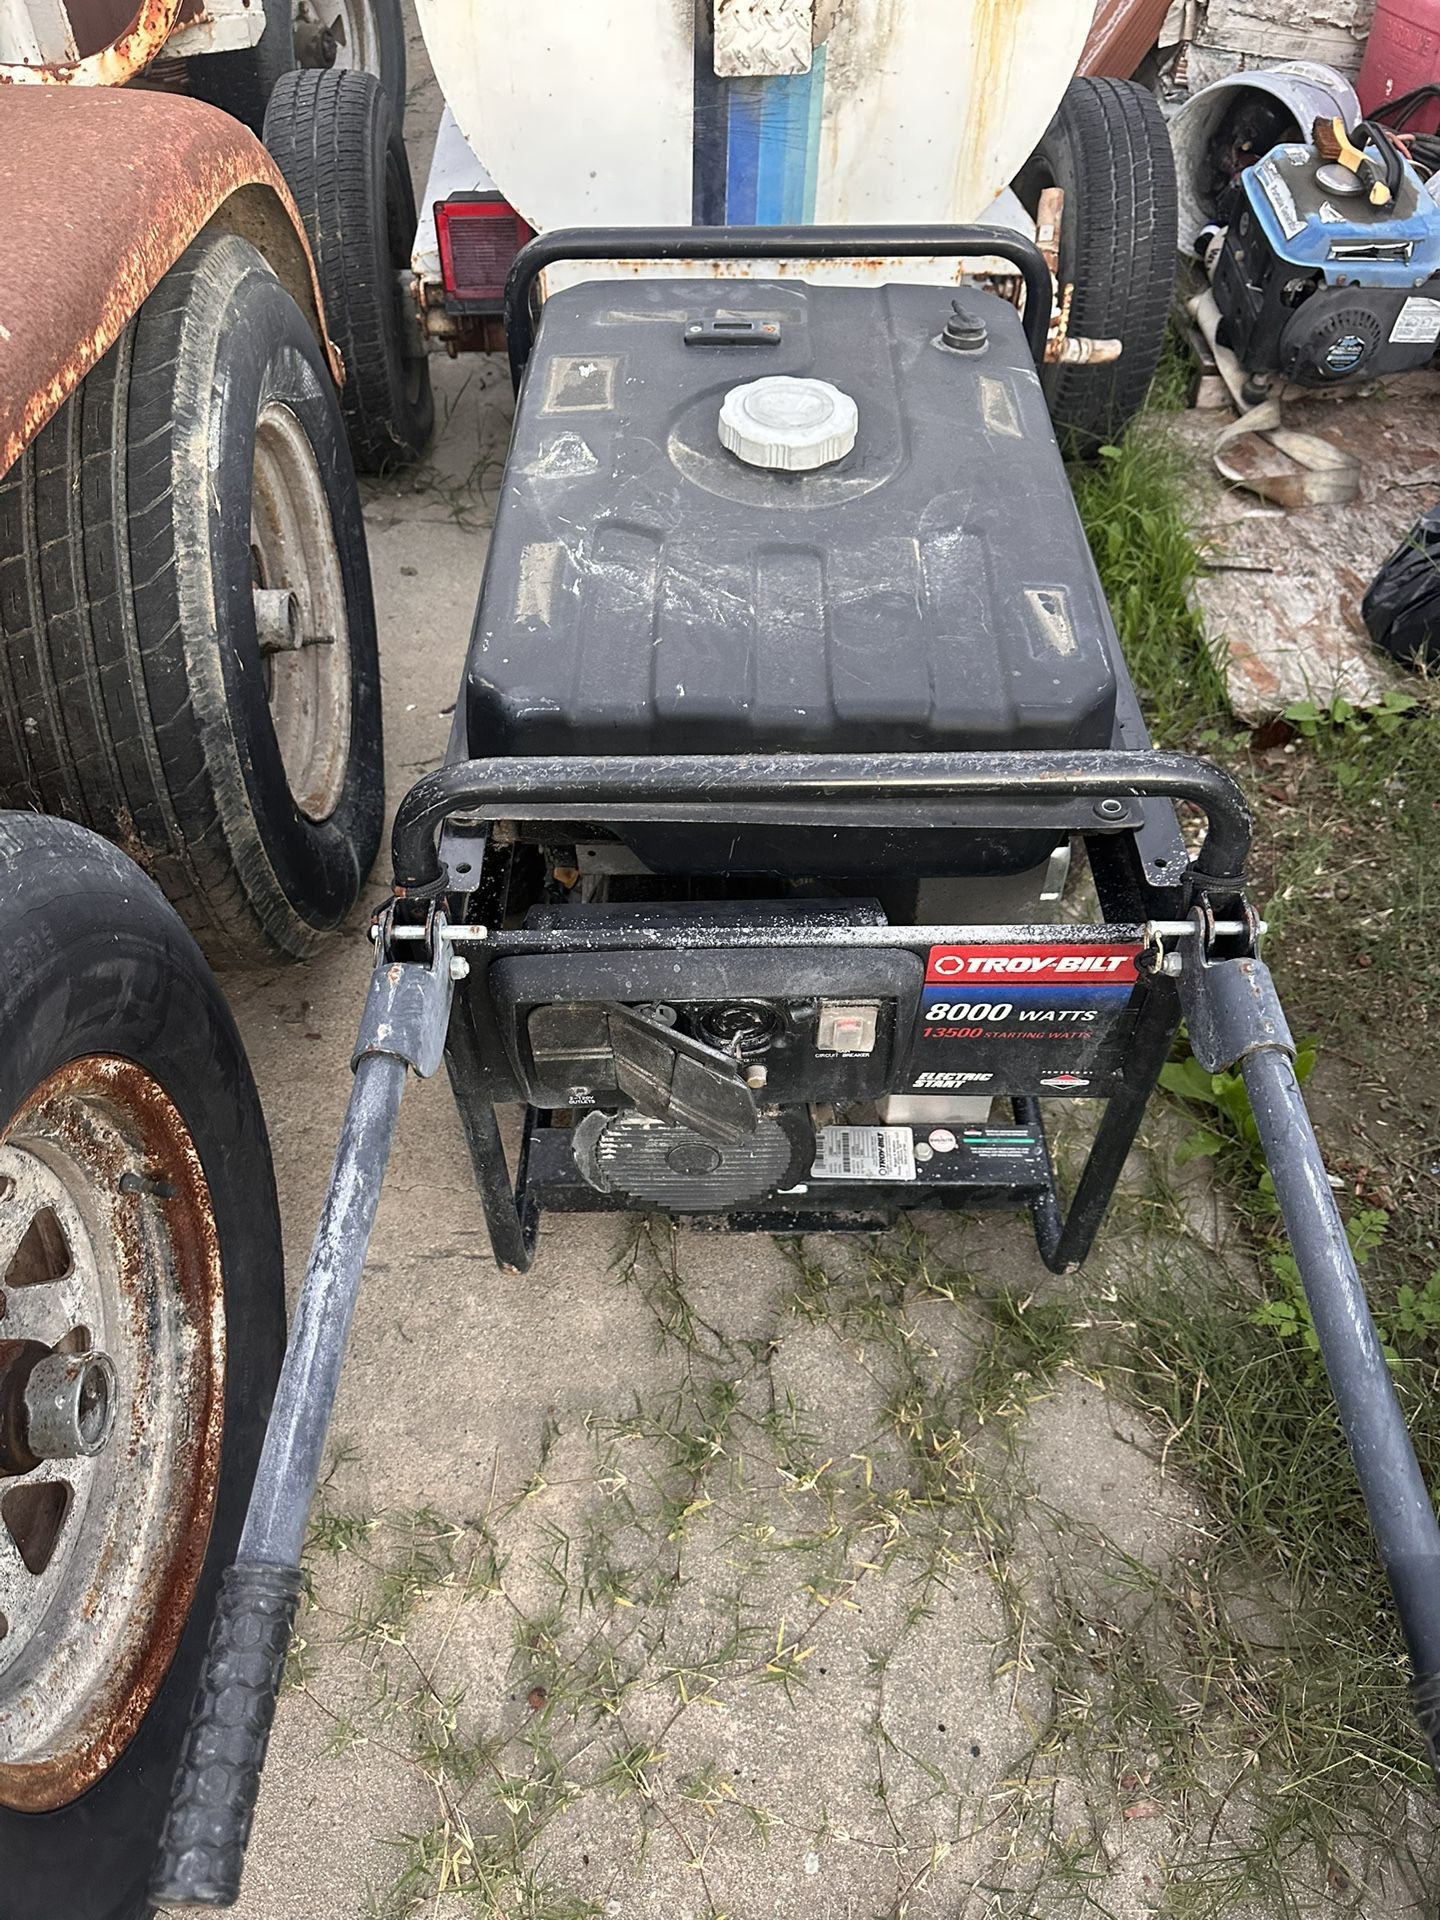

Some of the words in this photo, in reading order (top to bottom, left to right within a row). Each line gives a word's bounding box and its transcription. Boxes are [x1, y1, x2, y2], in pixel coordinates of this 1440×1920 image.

[967, 956, 1128, 973] TROY-BILT
[925, 1003, 1013, 1021] 8000
[1019, 1010, 1098, 1021] WATTS
[923, 1027, 983, 1039] 13500
[984, 1031, 1044, 1039] STARTING
[1048, 1031, 1093, 1039] WATTS
[920, 1072, 993, 1081] ELECTRIC
[912, 1080, 966, 1088] START
